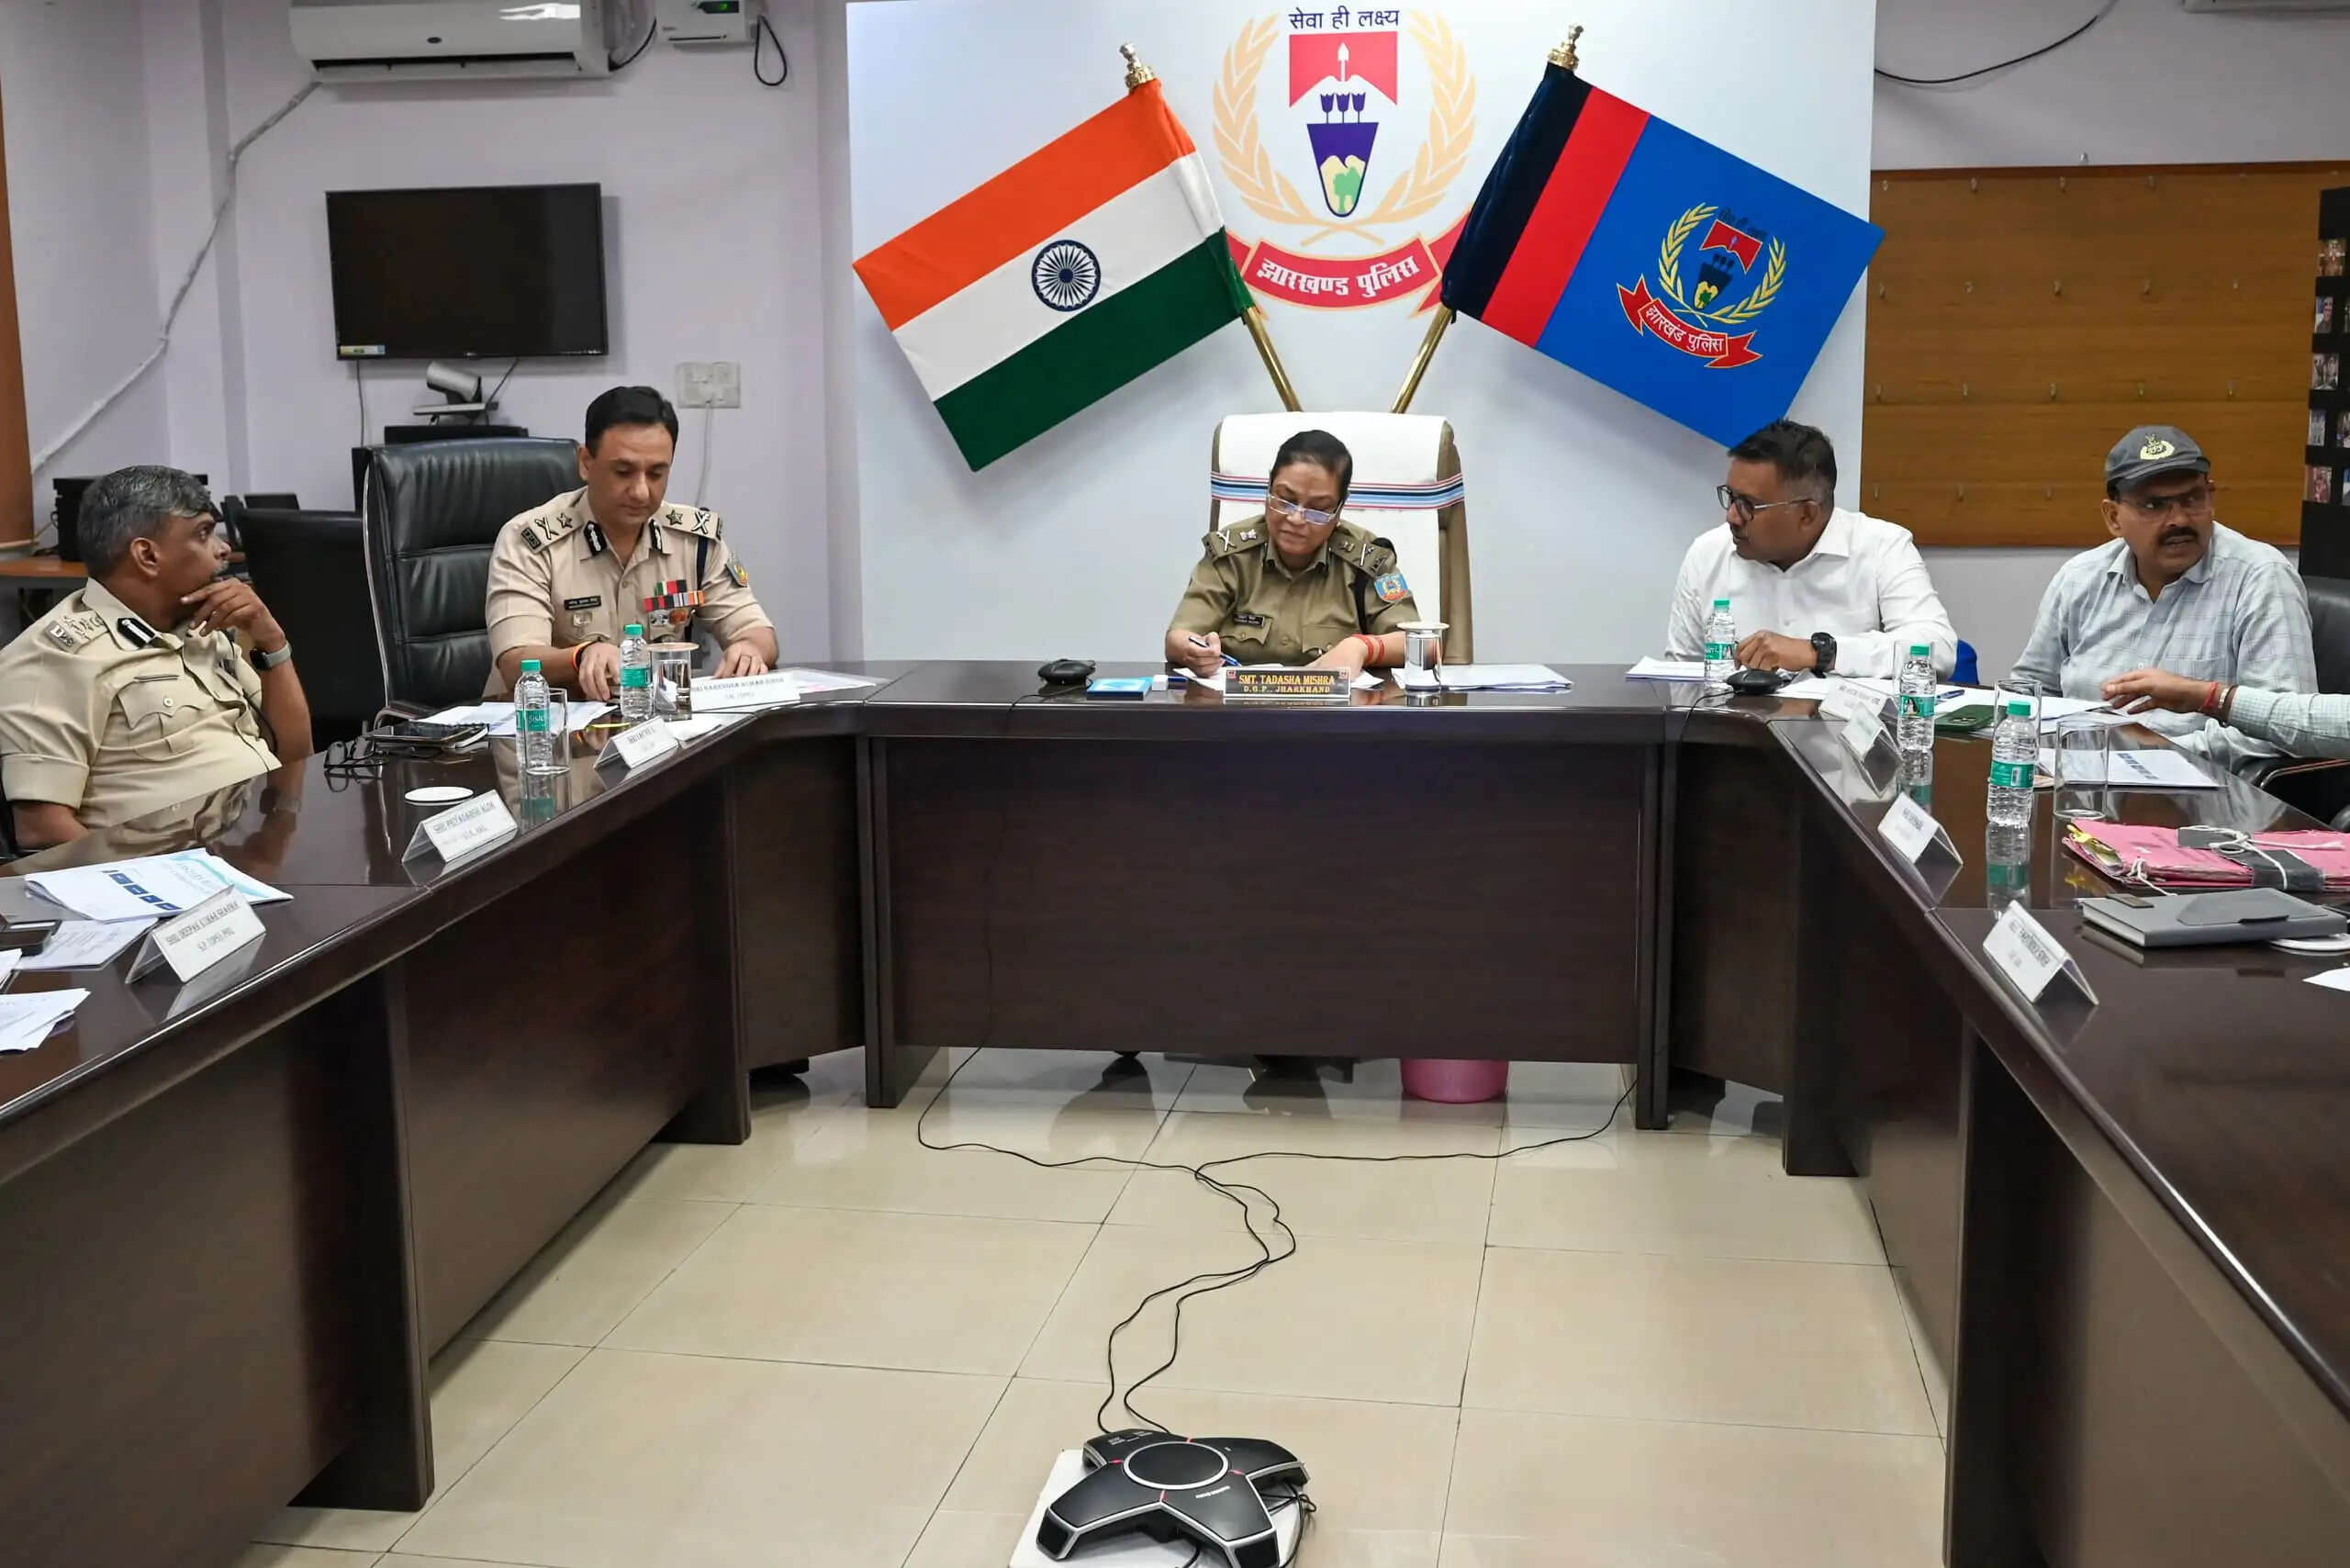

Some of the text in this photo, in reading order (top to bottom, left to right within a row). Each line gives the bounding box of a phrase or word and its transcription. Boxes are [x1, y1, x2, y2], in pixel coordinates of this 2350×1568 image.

[1289, 6, 1400, 29] सेवा ही लक्ष्य
[1257, 255, 1420, 297] झारखण्ड पुलिस
[1687, 333, 1724, 353] पुलिस
[1239, 675, 1336, 685] SMT. TADASHA MISHRA
[1276, 685, 1330, 693] JHARKHAND
